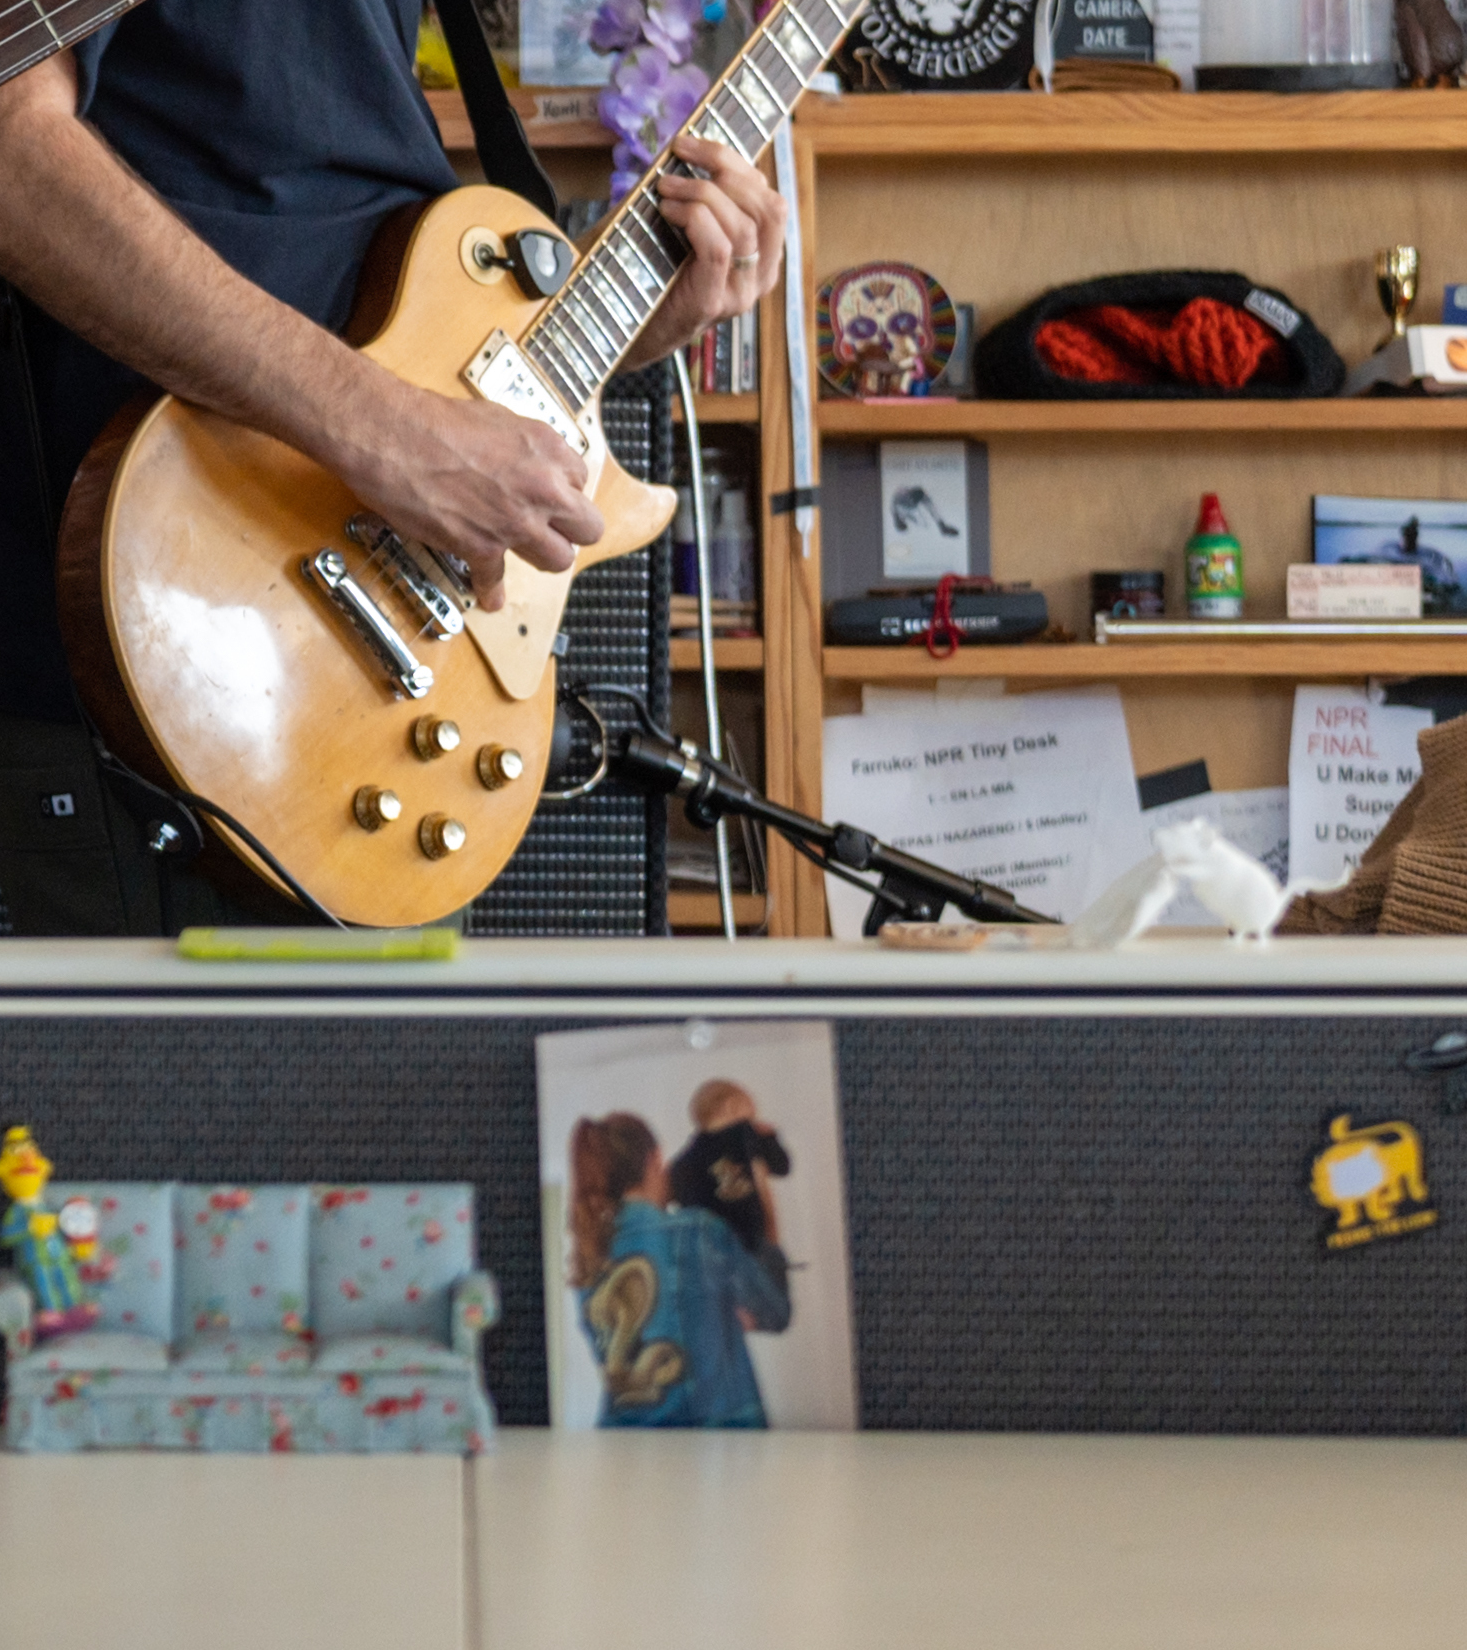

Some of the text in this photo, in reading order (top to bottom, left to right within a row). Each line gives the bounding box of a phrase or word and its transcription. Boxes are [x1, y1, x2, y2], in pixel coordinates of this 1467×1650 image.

[1082, 27, 1129, 49] DATE
[1316, 706, 1368, 730] NPR
[851, 732, 1059, 776] Farruko: NPR Tiny Desk
[1307, 733, 1379, 758] FINAL
[1316, 763, 1332, 783] U
[1337, 764, 1390, 784] Make
[992, 780, 1015, 796] MIA
[1345, 794, 1398, 816] Supe
[944, 820, 1016, 844] NAZARENO
[1035, 810, 1088, 831] (Medley)
[1315, 823, 1330, 841] U
